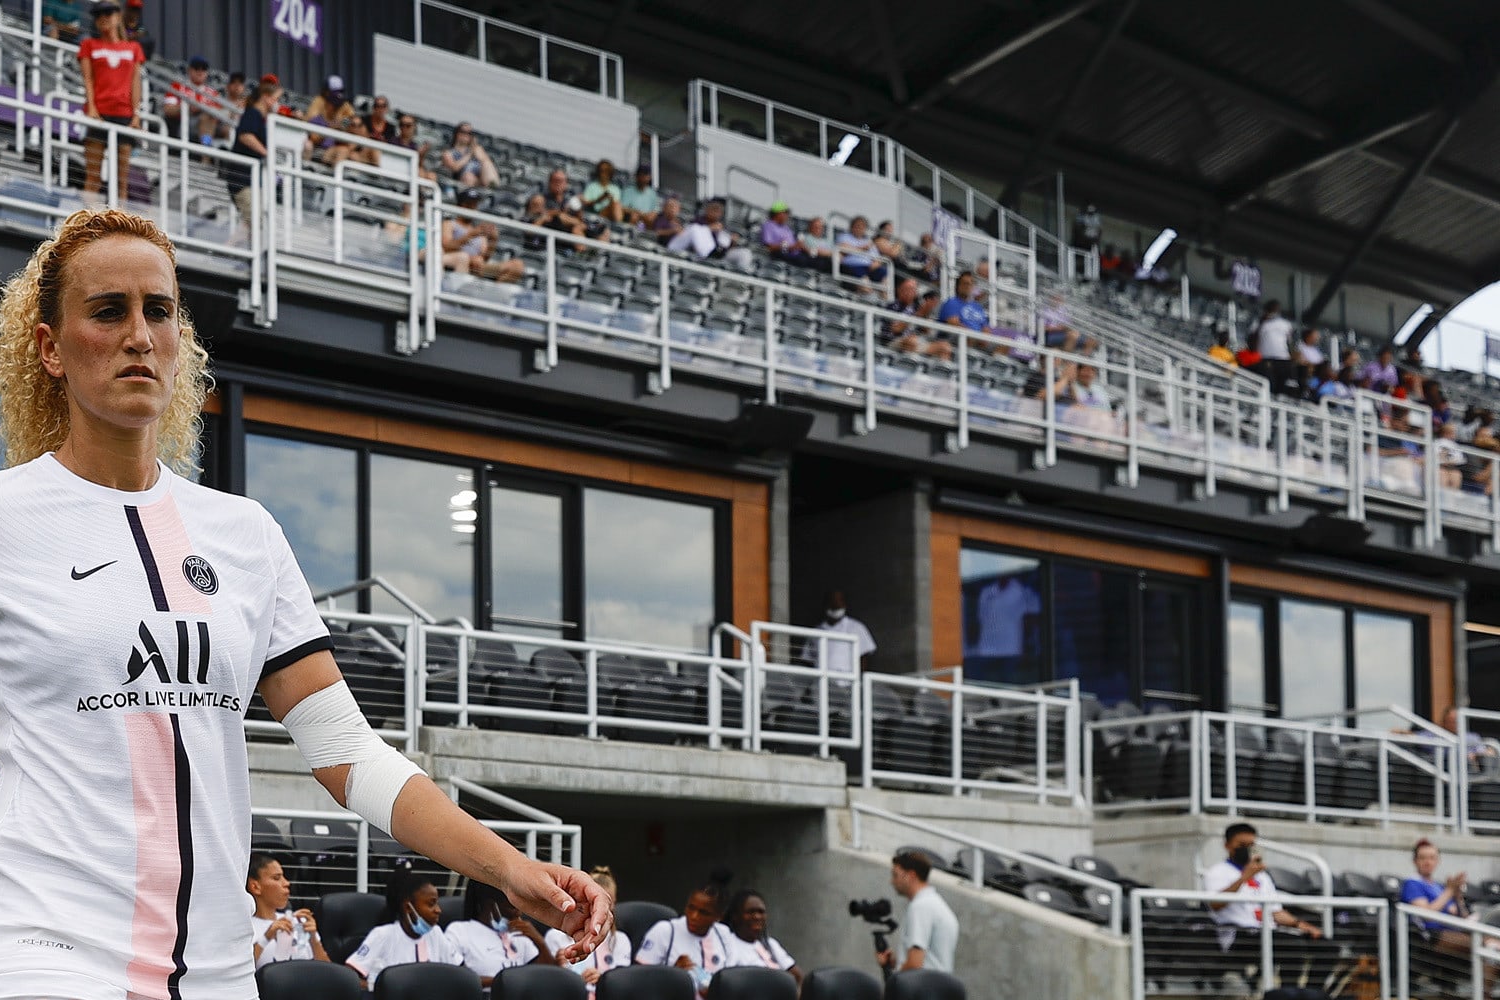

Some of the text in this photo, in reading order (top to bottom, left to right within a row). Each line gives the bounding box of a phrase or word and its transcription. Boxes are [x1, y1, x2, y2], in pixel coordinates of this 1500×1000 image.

[273, 0, 319, 47] 204
[76, 691, 140, 712] ACCOR
[145, 691, 175, 706] LIVE
